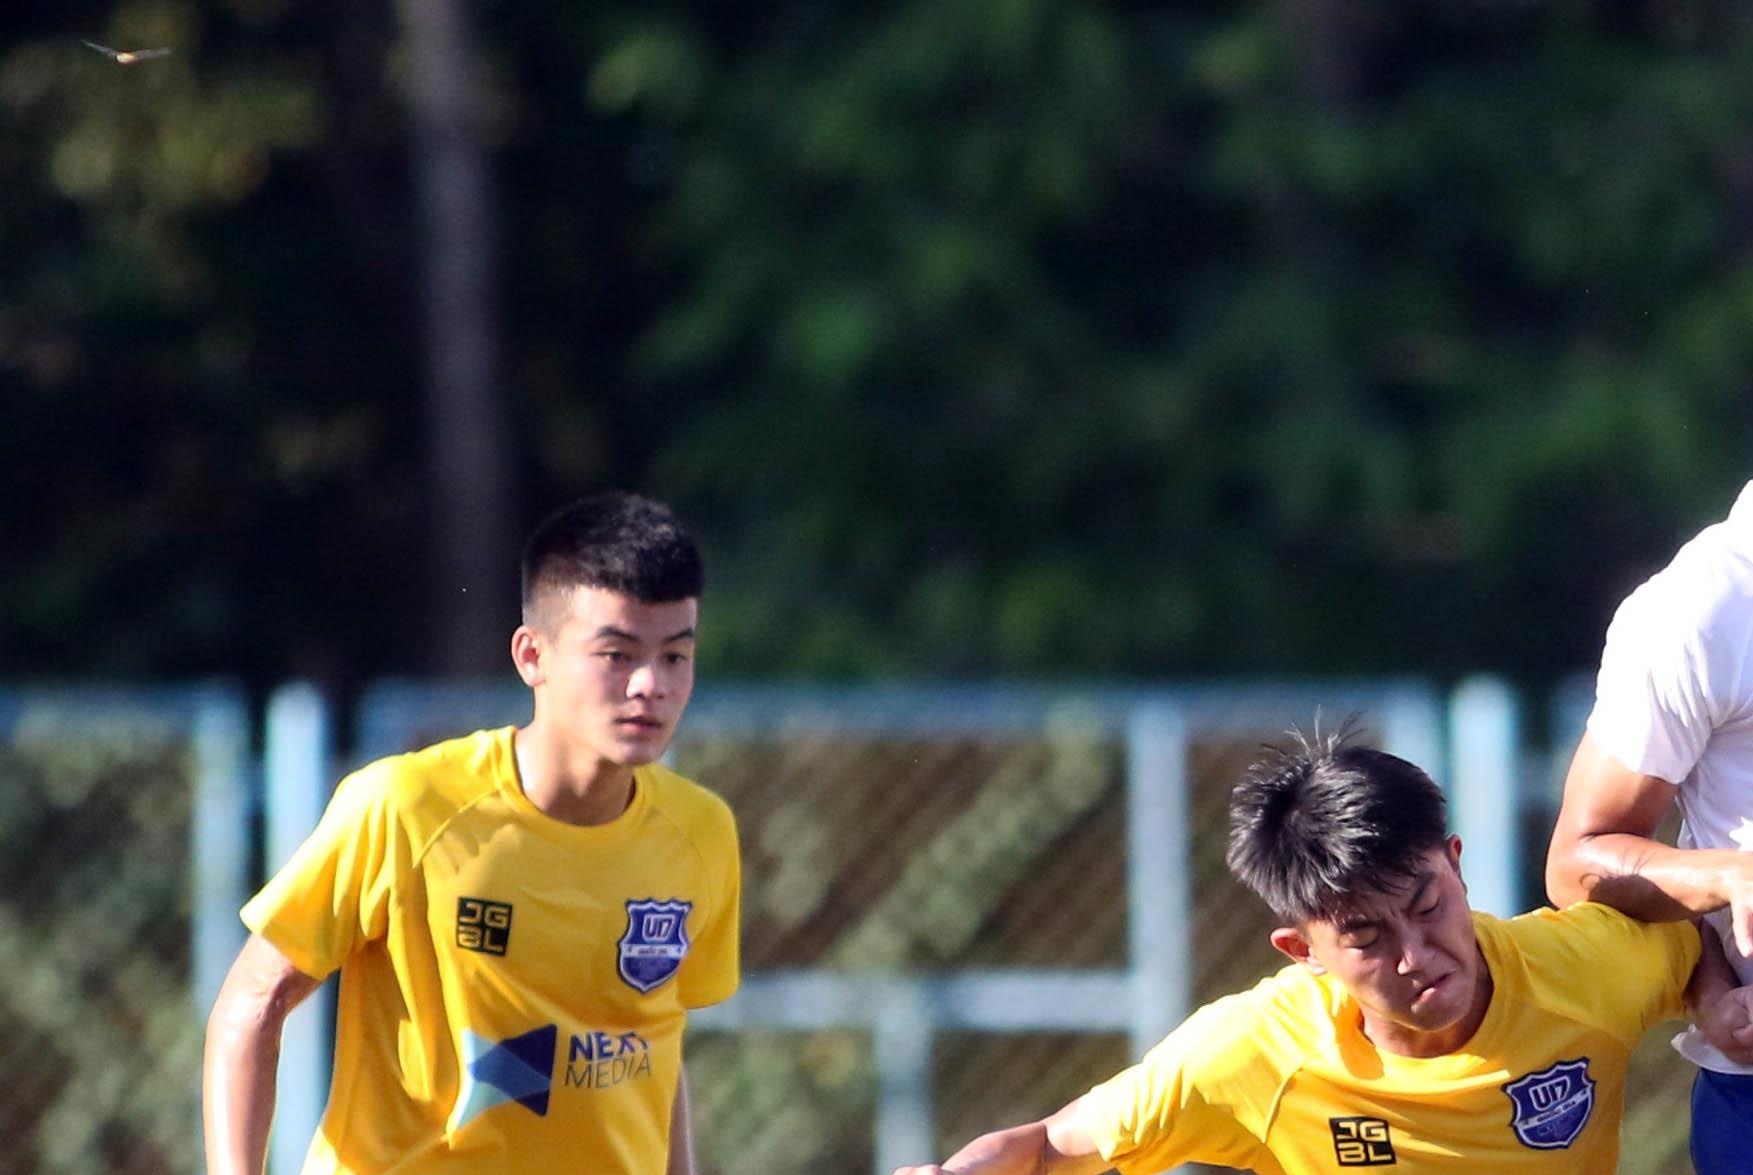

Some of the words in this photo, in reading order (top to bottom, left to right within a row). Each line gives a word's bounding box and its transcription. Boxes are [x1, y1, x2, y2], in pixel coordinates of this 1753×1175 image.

[642, 913, 675, 941] U17
[564, 1051, 652, 1090] MEDIA
[1528, 1076, 1570, 1111] U17
